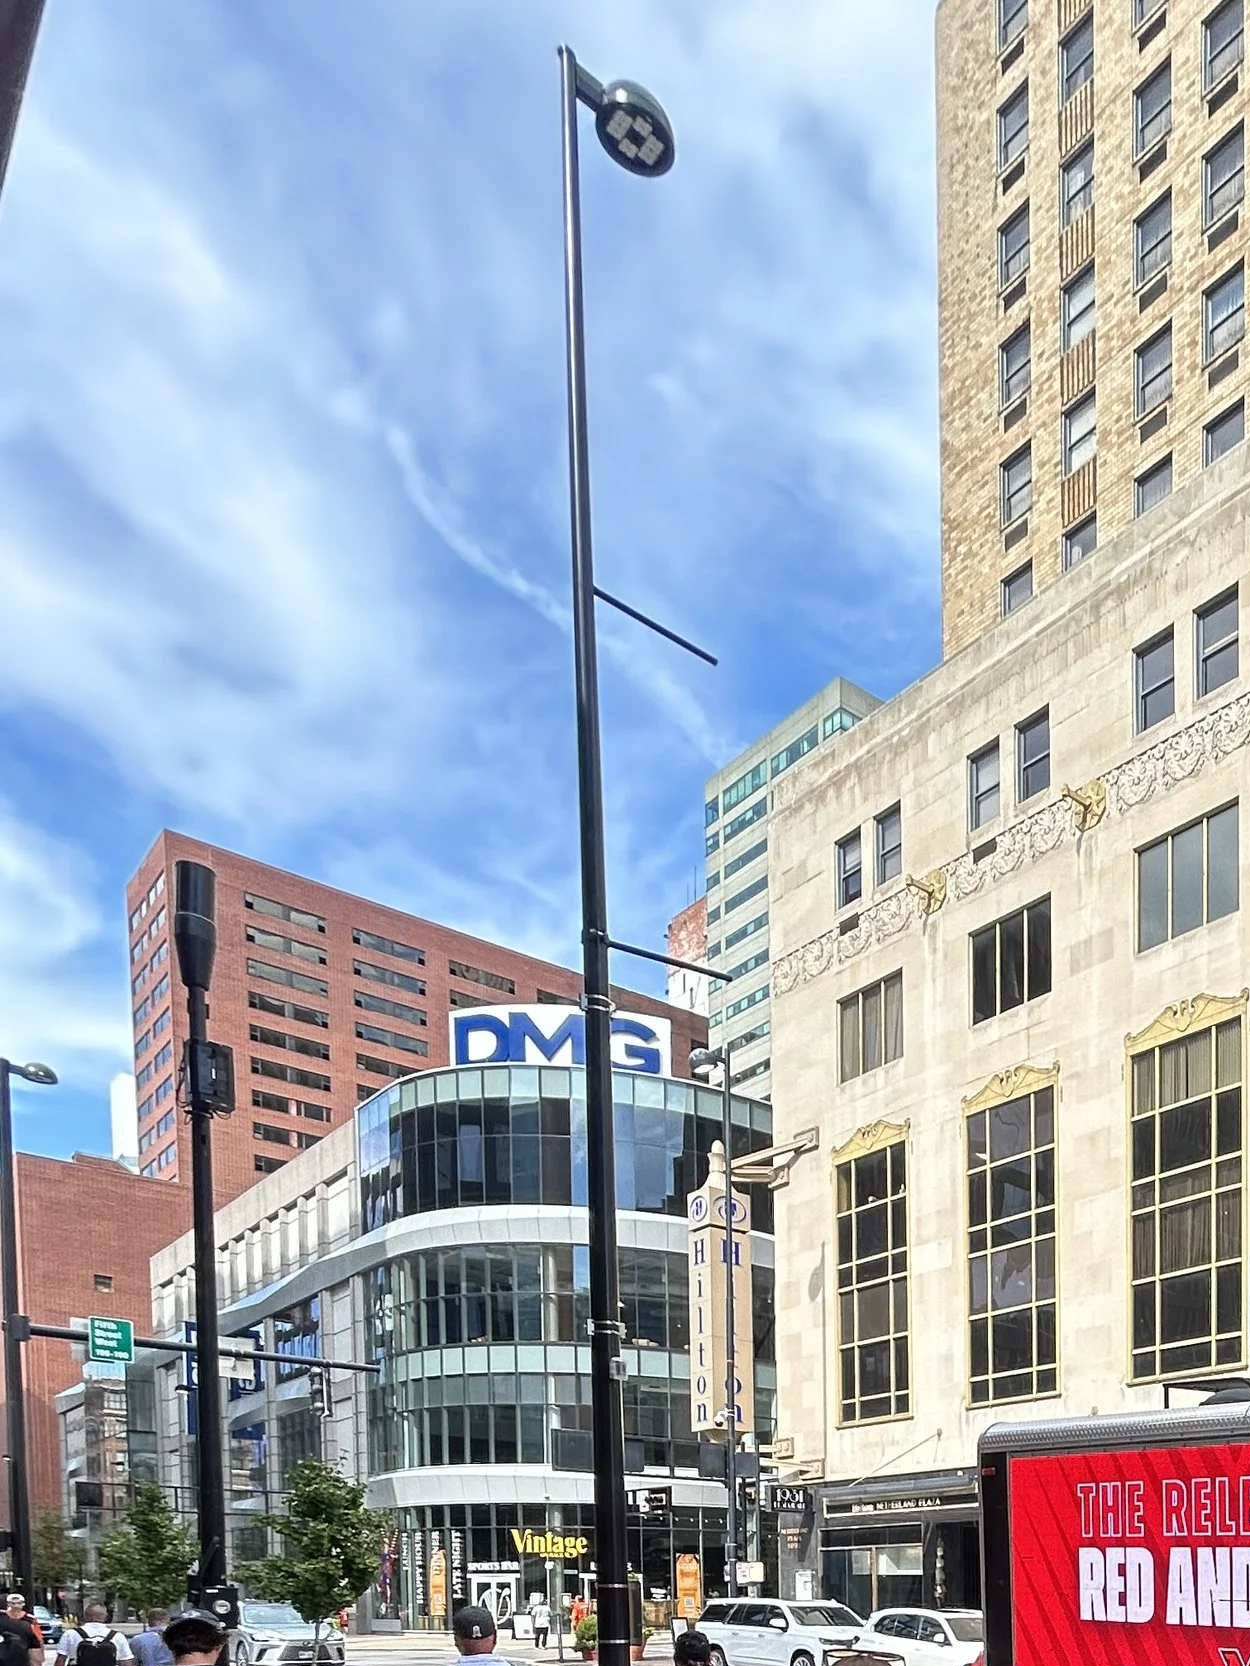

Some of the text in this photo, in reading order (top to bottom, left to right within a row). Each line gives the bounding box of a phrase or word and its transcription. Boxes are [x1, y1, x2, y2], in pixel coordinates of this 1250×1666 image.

[453, 1011, 660, 1074] DMG
[693, 1238, 708, 1423] Hilton
[1077, 1480, 1145, 1538] THE
[467, 1562, 501, 1571] SPORTS
[509, 1528, 589, 1559] Vintage
[1078, 1546, 1155, 1624] RED
